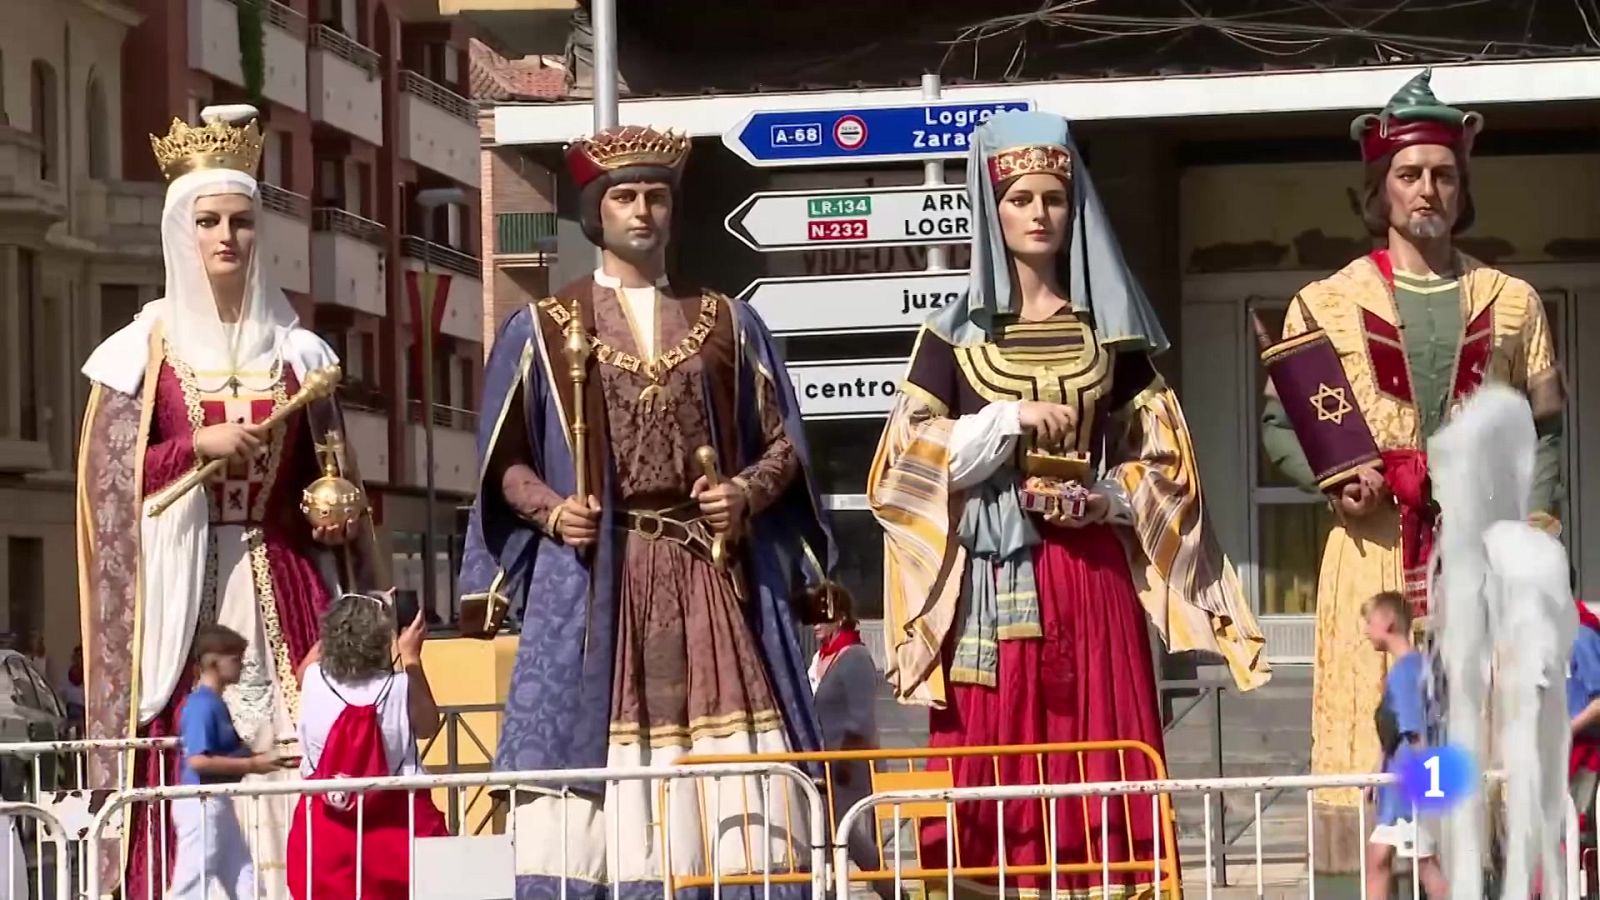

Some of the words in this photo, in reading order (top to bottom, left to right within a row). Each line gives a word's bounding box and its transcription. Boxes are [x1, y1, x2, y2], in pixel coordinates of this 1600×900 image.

[775, 127, 818, 144] A-68
[811, 200, 867, 215] LR-134
[812, 223, 864, 238] N-232
[905, 217, 969, 236] LOGR
[805, 378, 896, 399] centro
